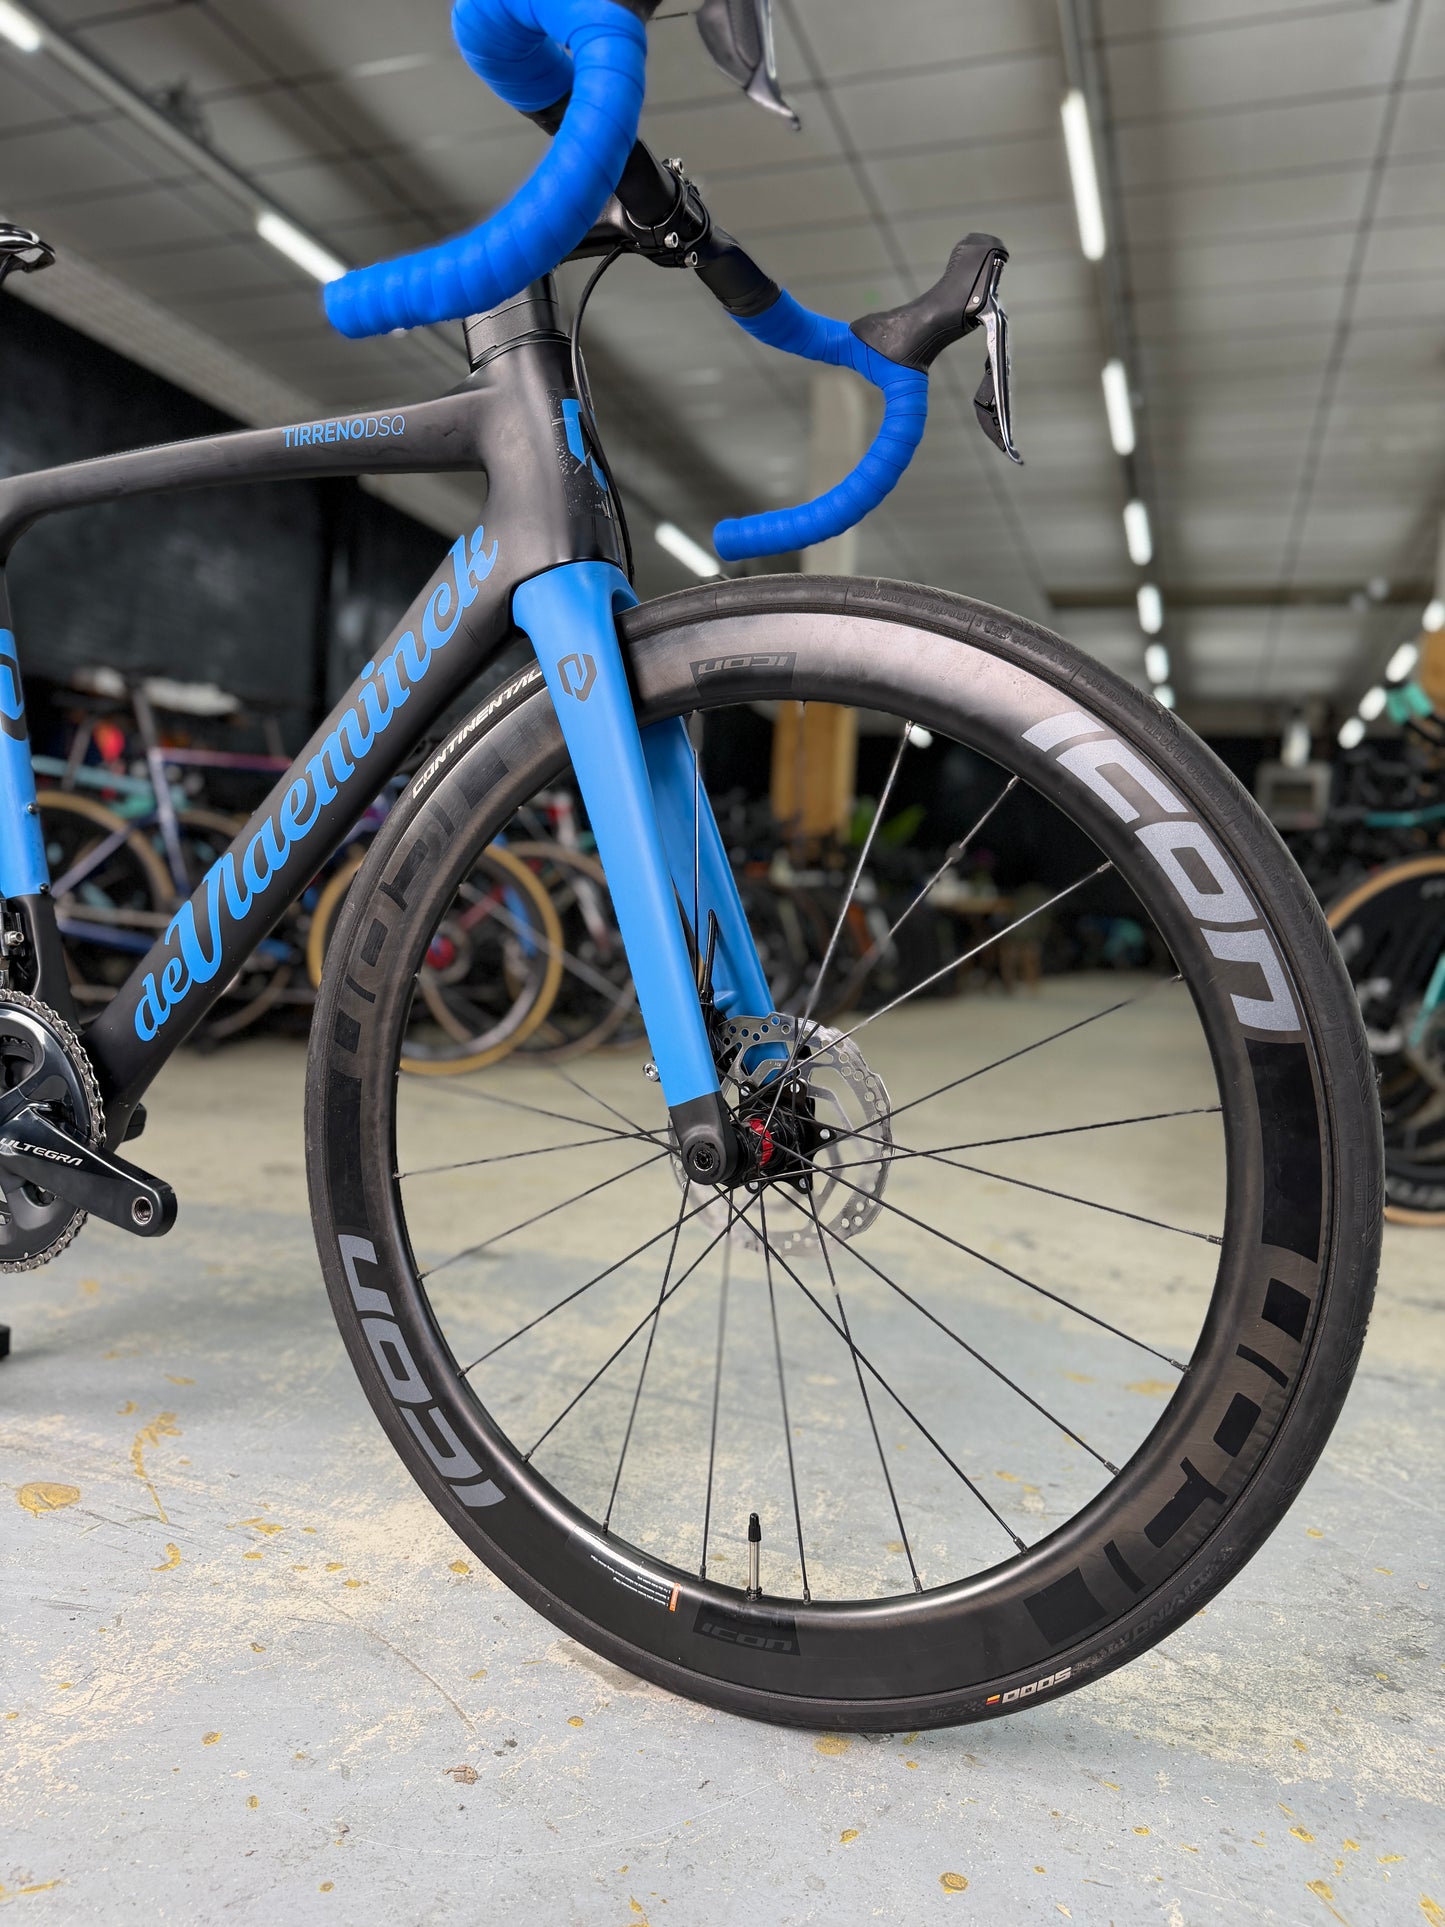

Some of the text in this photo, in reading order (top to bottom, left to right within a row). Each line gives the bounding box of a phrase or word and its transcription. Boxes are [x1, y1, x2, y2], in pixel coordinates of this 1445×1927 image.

[412, 669, 543, 799] CONTINENTAL
[0, 1137, 84, 1166] ULTEGRA
[1002, 1666, 1072, 1704] 5000
